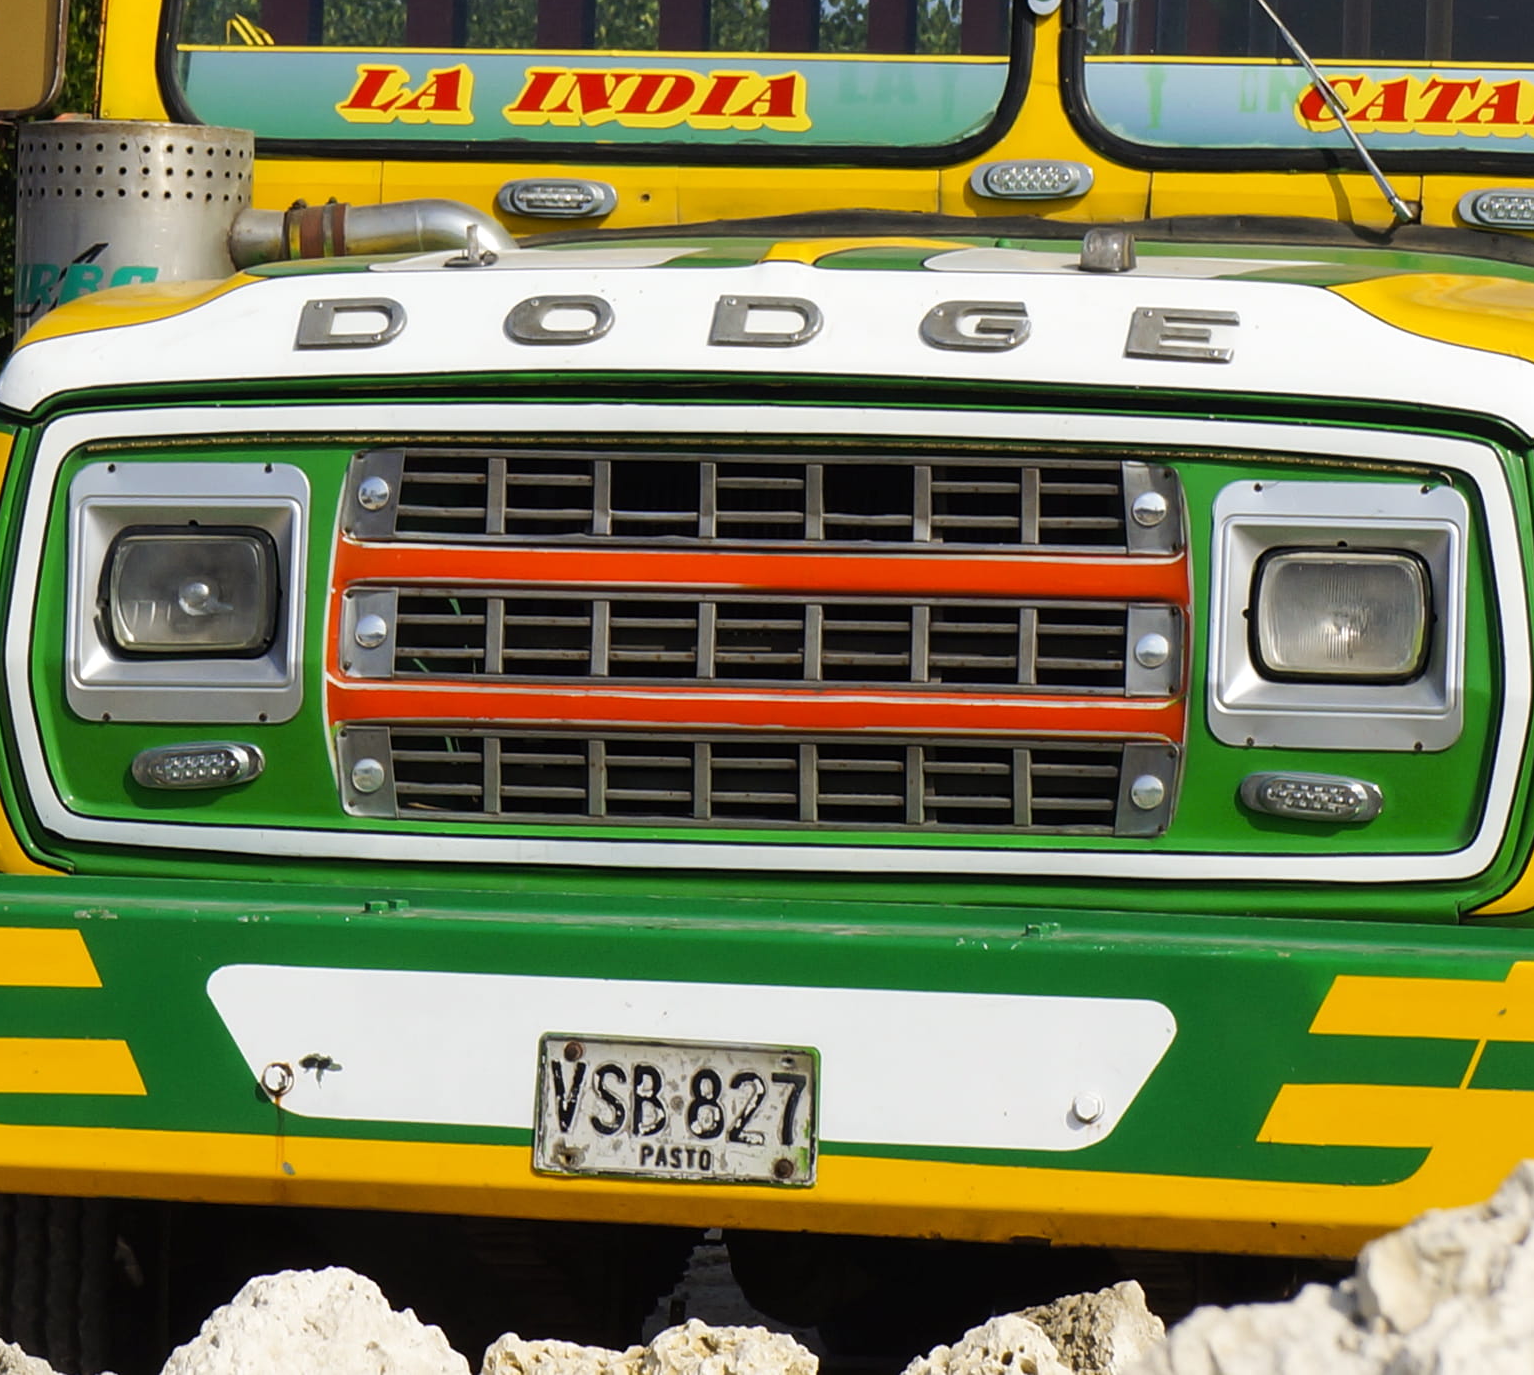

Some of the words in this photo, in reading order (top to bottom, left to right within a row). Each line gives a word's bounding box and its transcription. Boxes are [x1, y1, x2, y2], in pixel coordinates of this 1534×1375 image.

[337, 66, 471, 121] LA
[504, 69, 808, 129] INDIA
[293, 294, 1242, 365] DODGE
[550, 1059, 669, 1138] VSB
[686, 1068, 808, 1147] 827
[639, 1143, 712, 1172] PASTO
